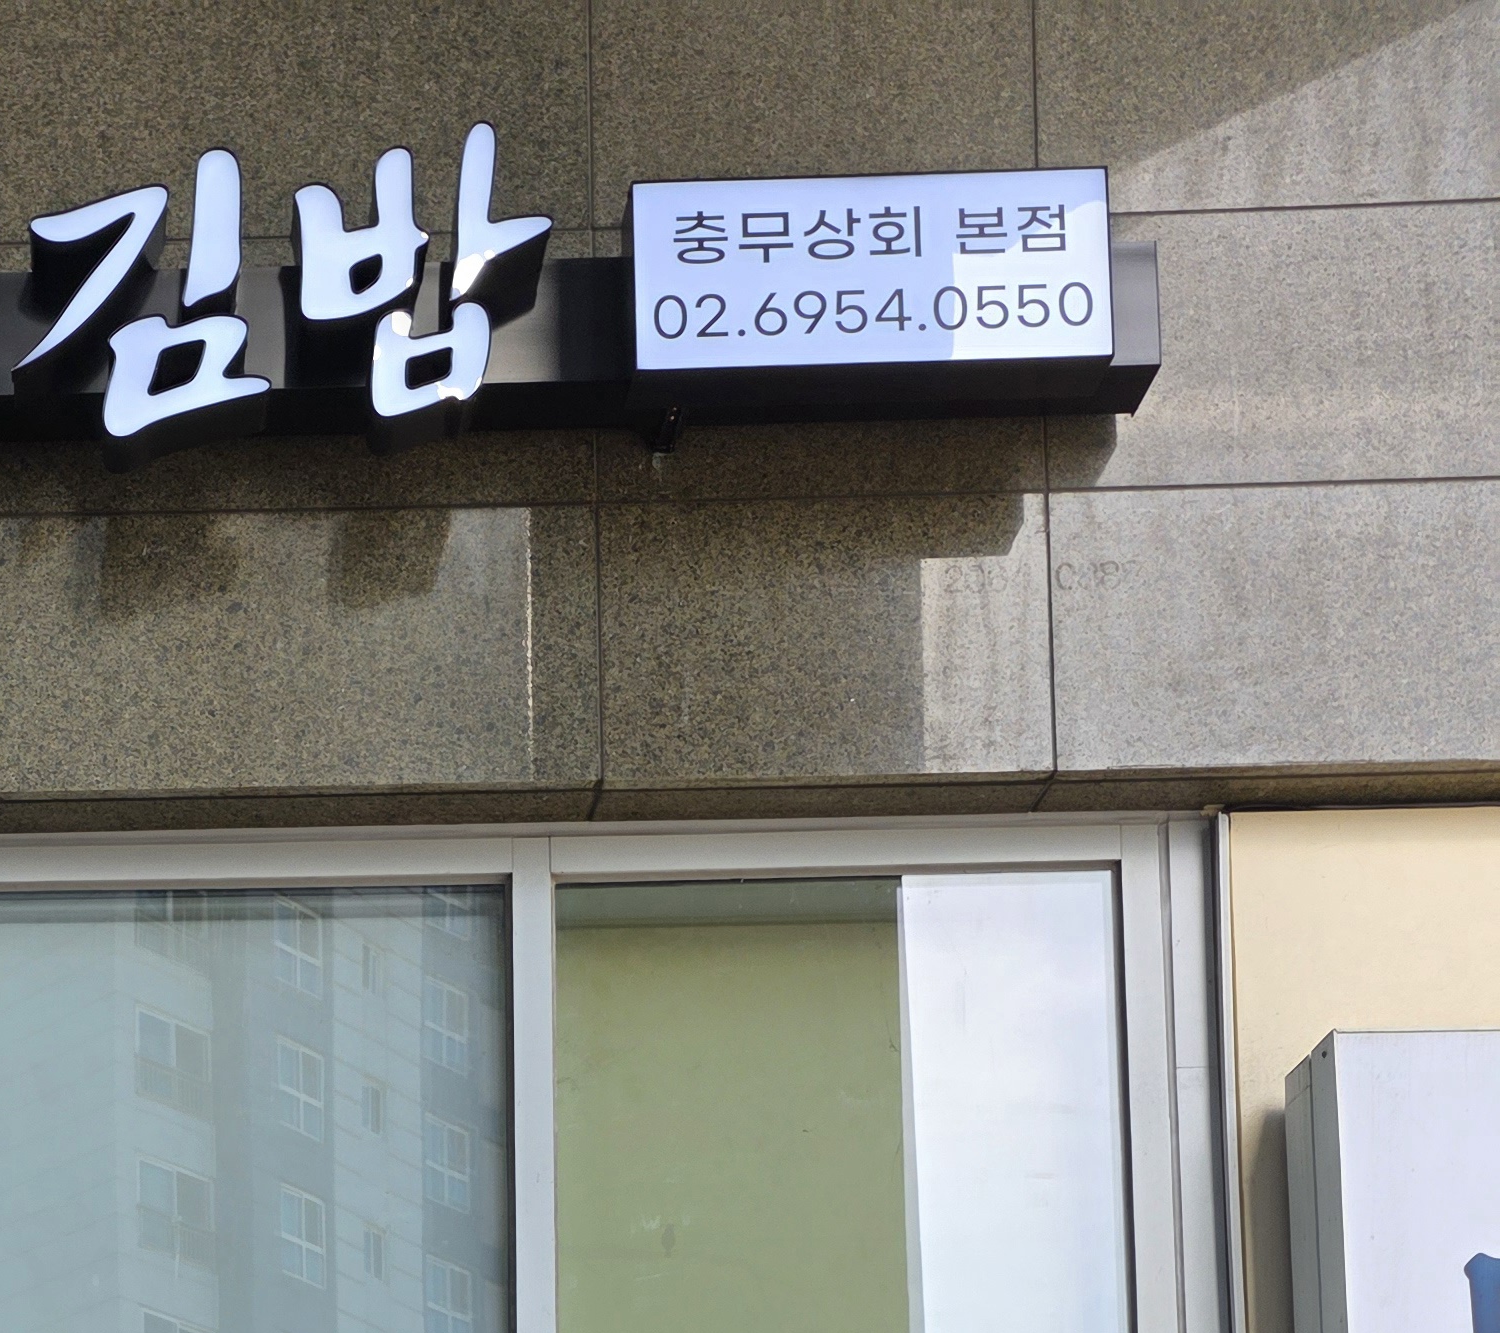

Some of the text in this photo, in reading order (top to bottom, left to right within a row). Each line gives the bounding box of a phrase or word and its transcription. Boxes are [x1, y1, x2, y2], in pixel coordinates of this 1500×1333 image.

[672, 203, 1067, 265] 충무상회 본점
[653, 280, 1094, 340] 02.6954.0550
